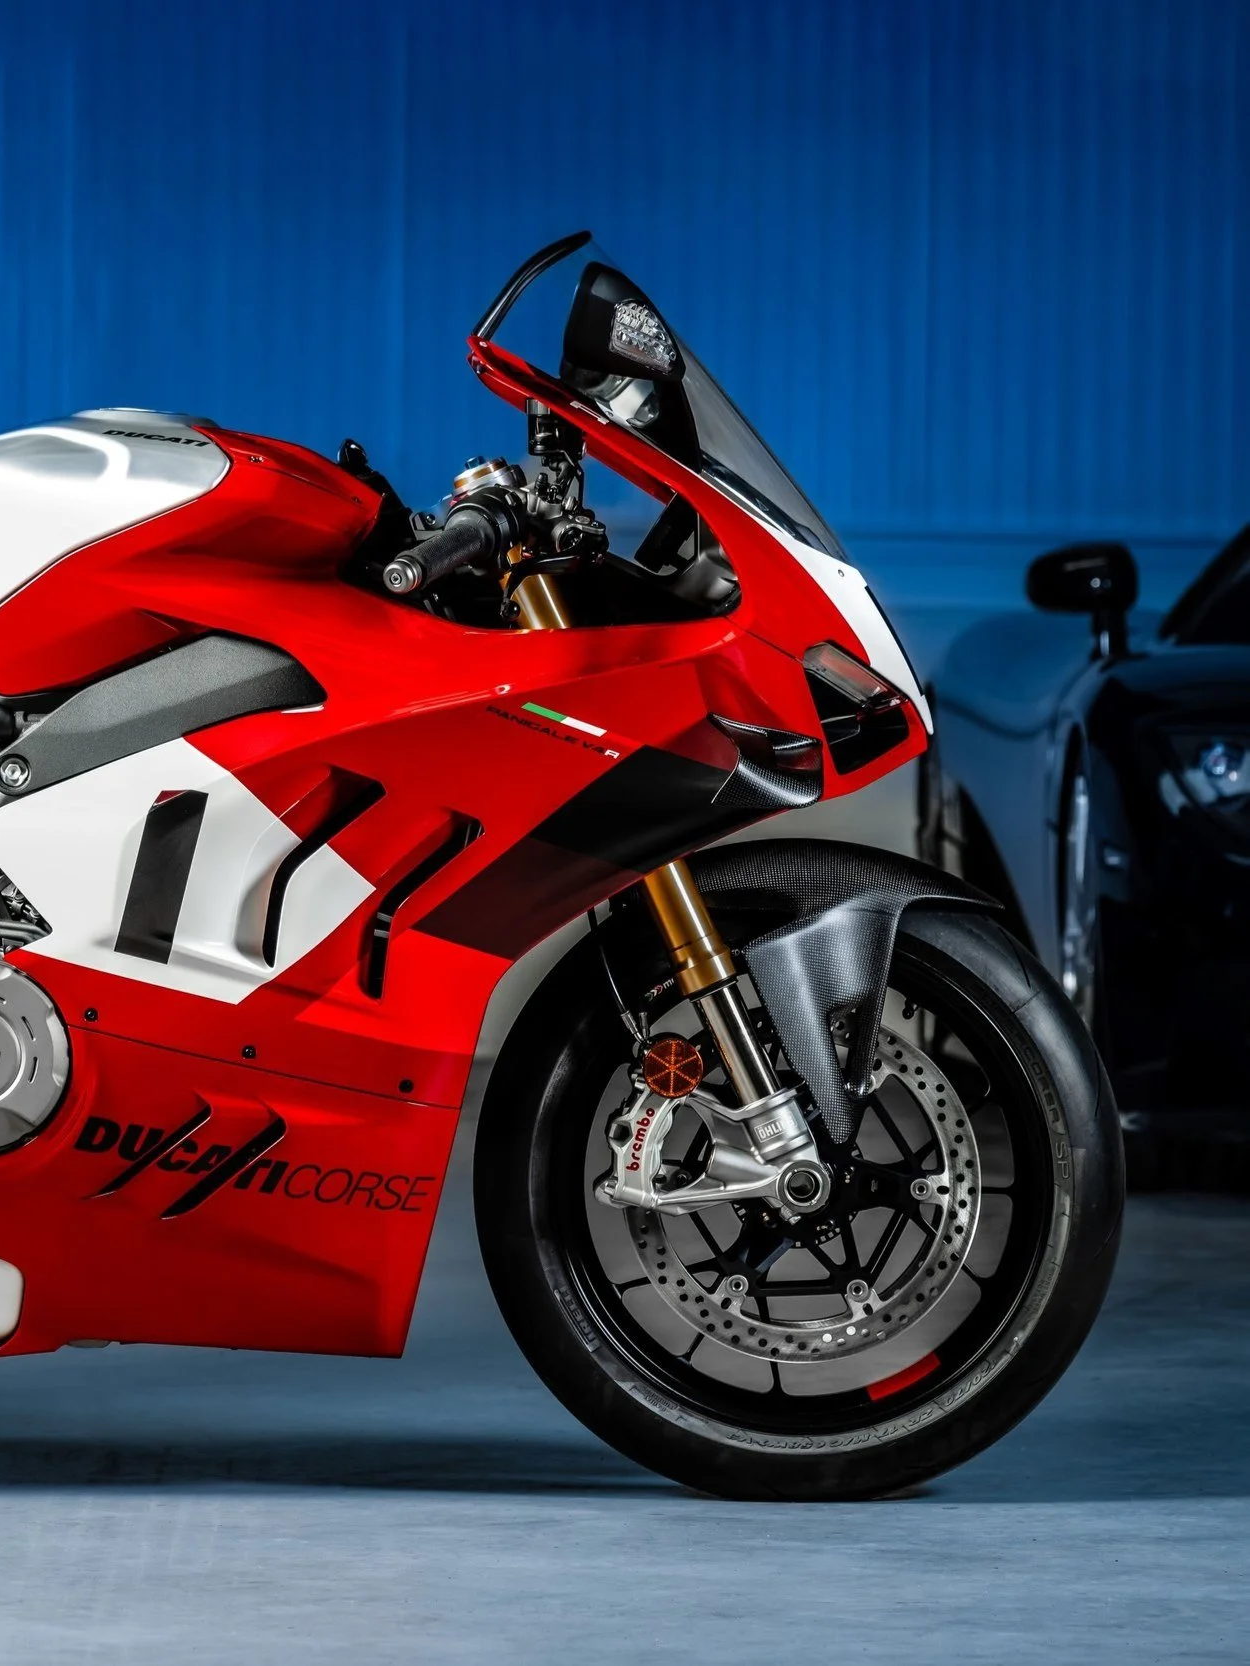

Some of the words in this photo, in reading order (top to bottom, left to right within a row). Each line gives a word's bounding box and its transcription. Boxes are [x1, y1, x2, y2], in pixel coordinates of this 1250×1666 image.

[102, 429, 211, 447] DUCATI
[485, 705, 580, 745] PANIGALE
[625, 1107, 656, 1172] brembo
[73, 1116, 290, 1194] DUCATI
[284, 1164, 436, 1212] CORSE
[1055, 1141, 1070, 1180] SP
